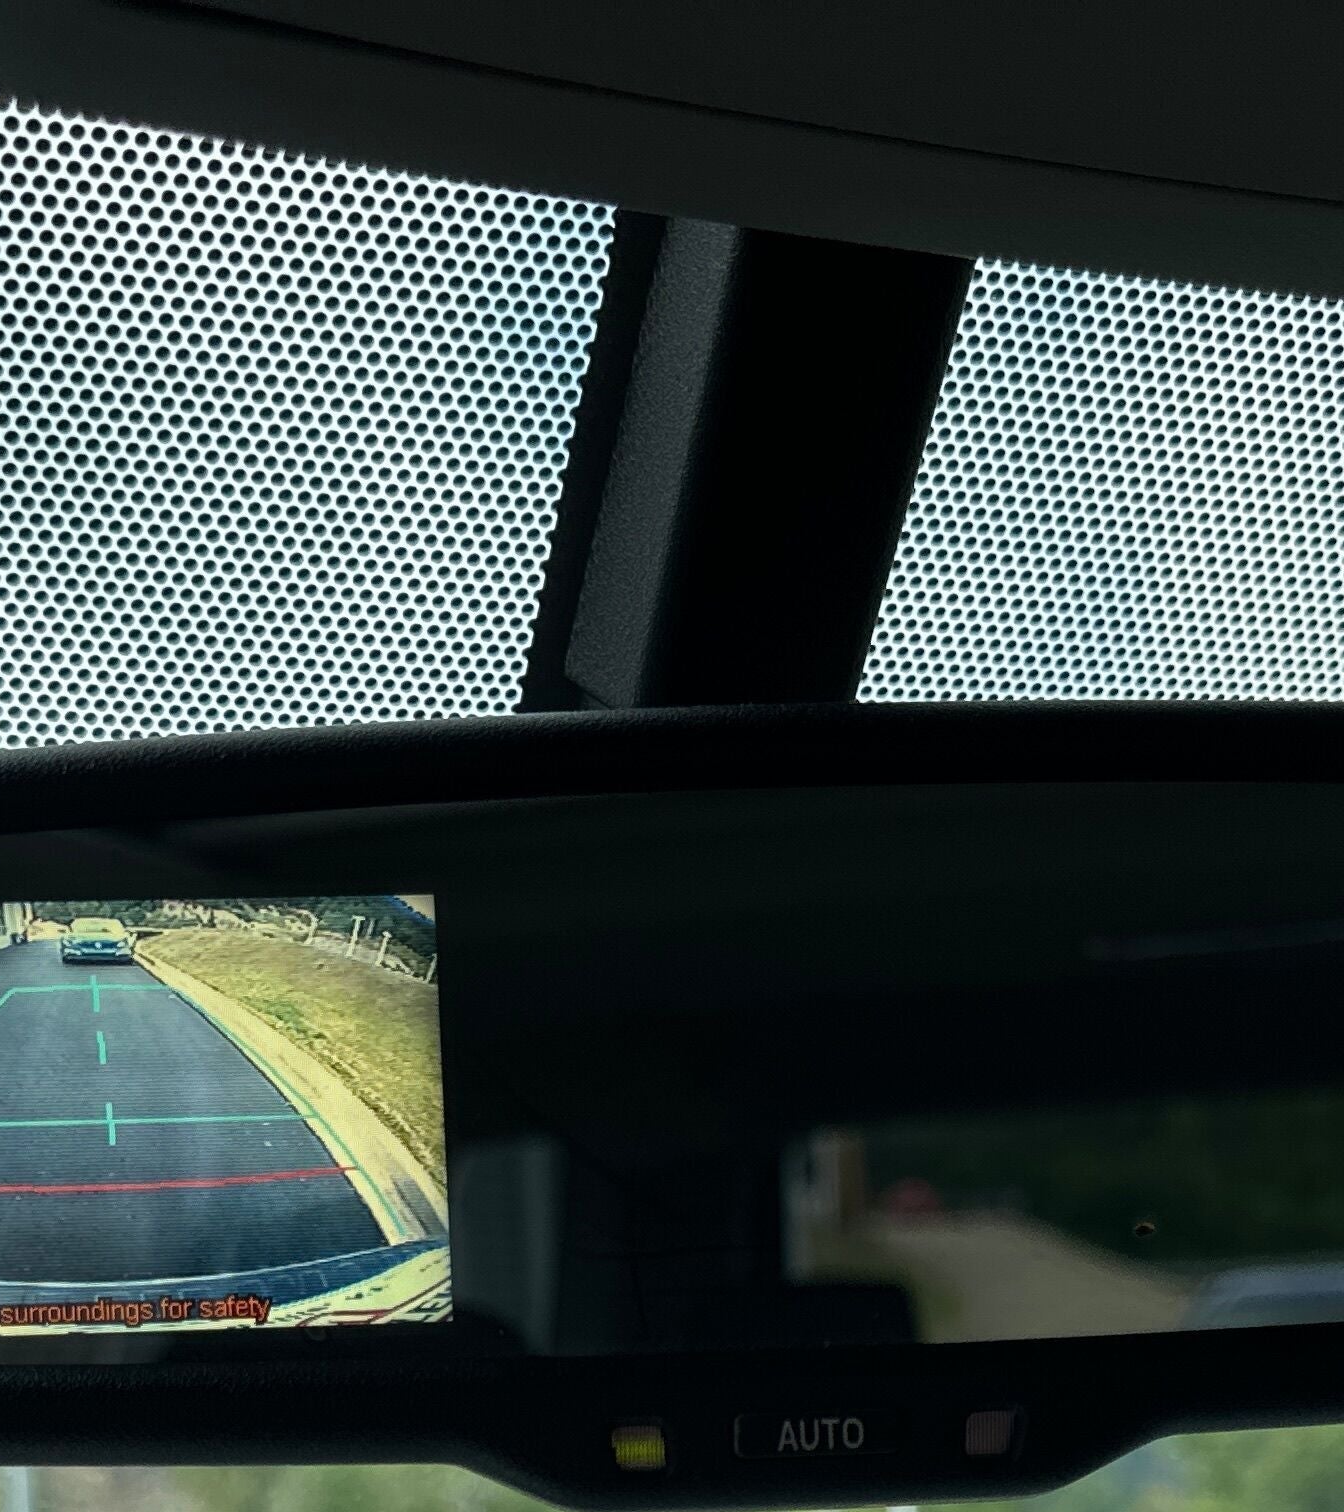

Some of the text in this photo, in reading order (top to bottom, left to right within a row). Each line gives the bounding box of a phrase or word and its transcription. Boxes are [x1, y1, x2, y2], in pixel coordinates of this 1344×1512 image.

[0, 1299, 153, 1323] surroundings
[160, 1297, 192, 1317] for
[200, 1296, 270, 1321] safety
[778, 1418, 865, 1452] AUTO
